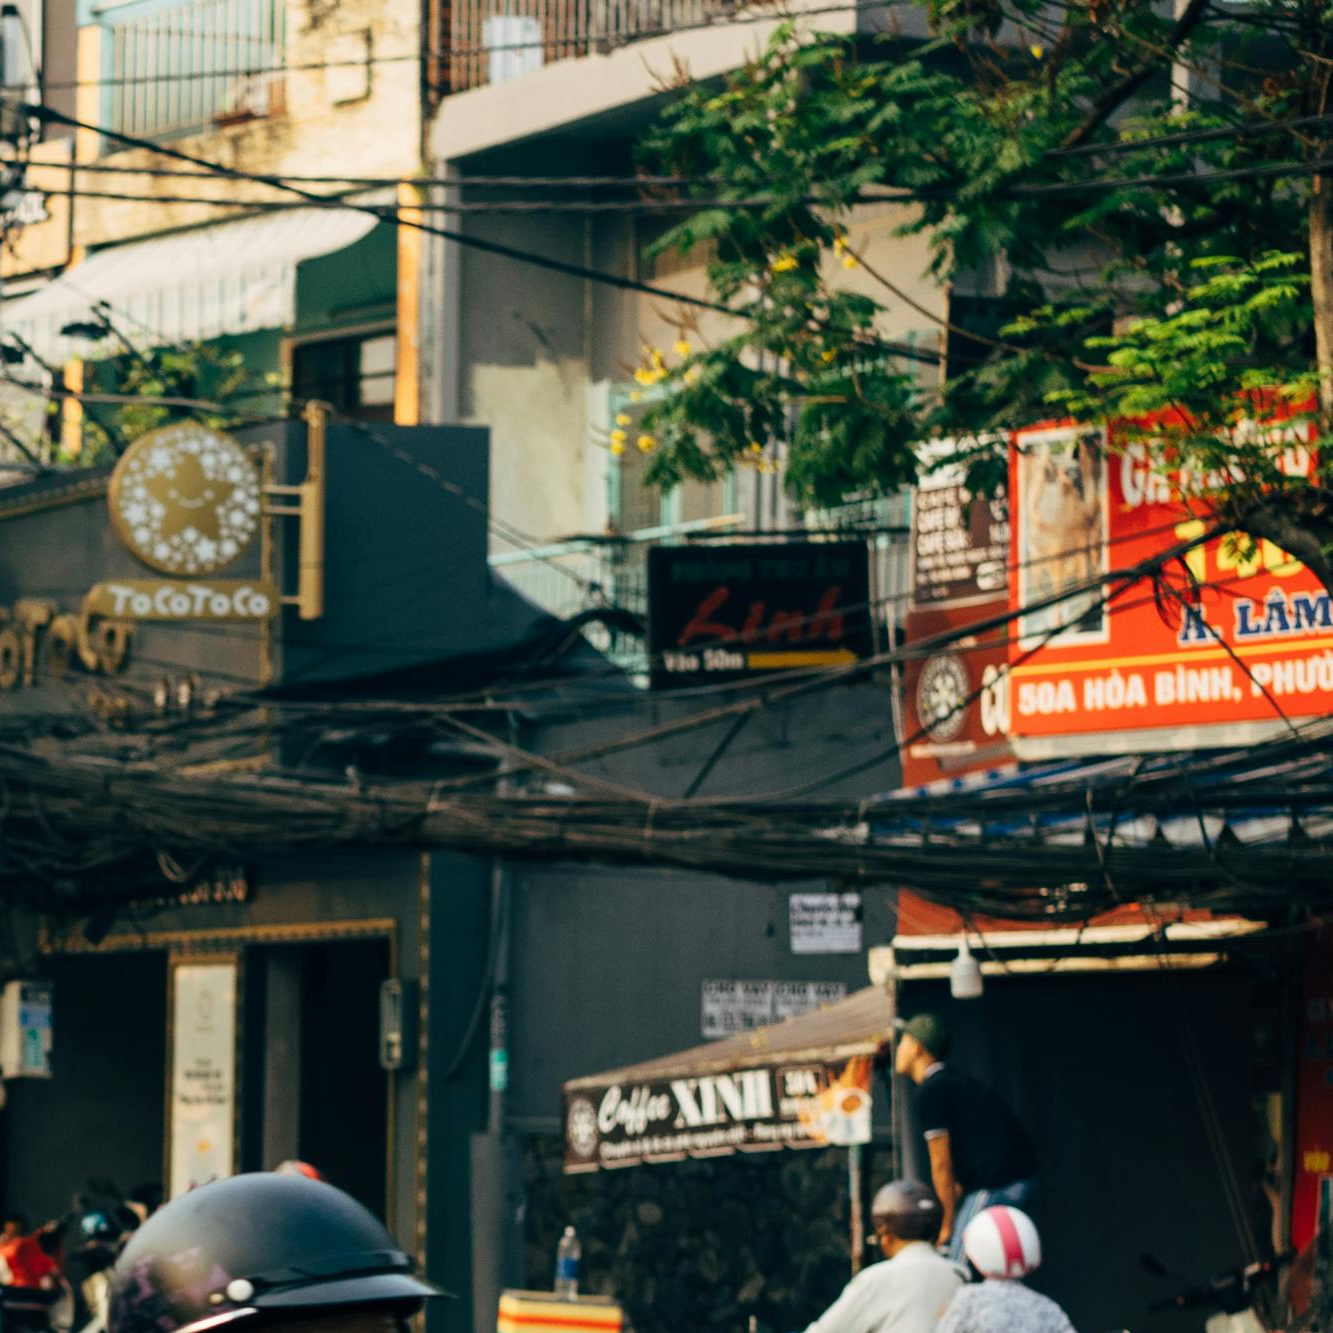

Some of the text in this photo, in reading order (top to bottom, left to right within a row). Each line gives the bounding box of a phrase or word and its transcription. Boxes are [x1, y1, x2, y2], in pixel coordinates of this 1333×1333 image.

[106, 583, 270, 617] ToCoToCo
[1017, 679, 1077, 716] 50A
[1083, 667, 1148, 711] HÒA
[598, 1068, 774, 1135] Coffee XINH
